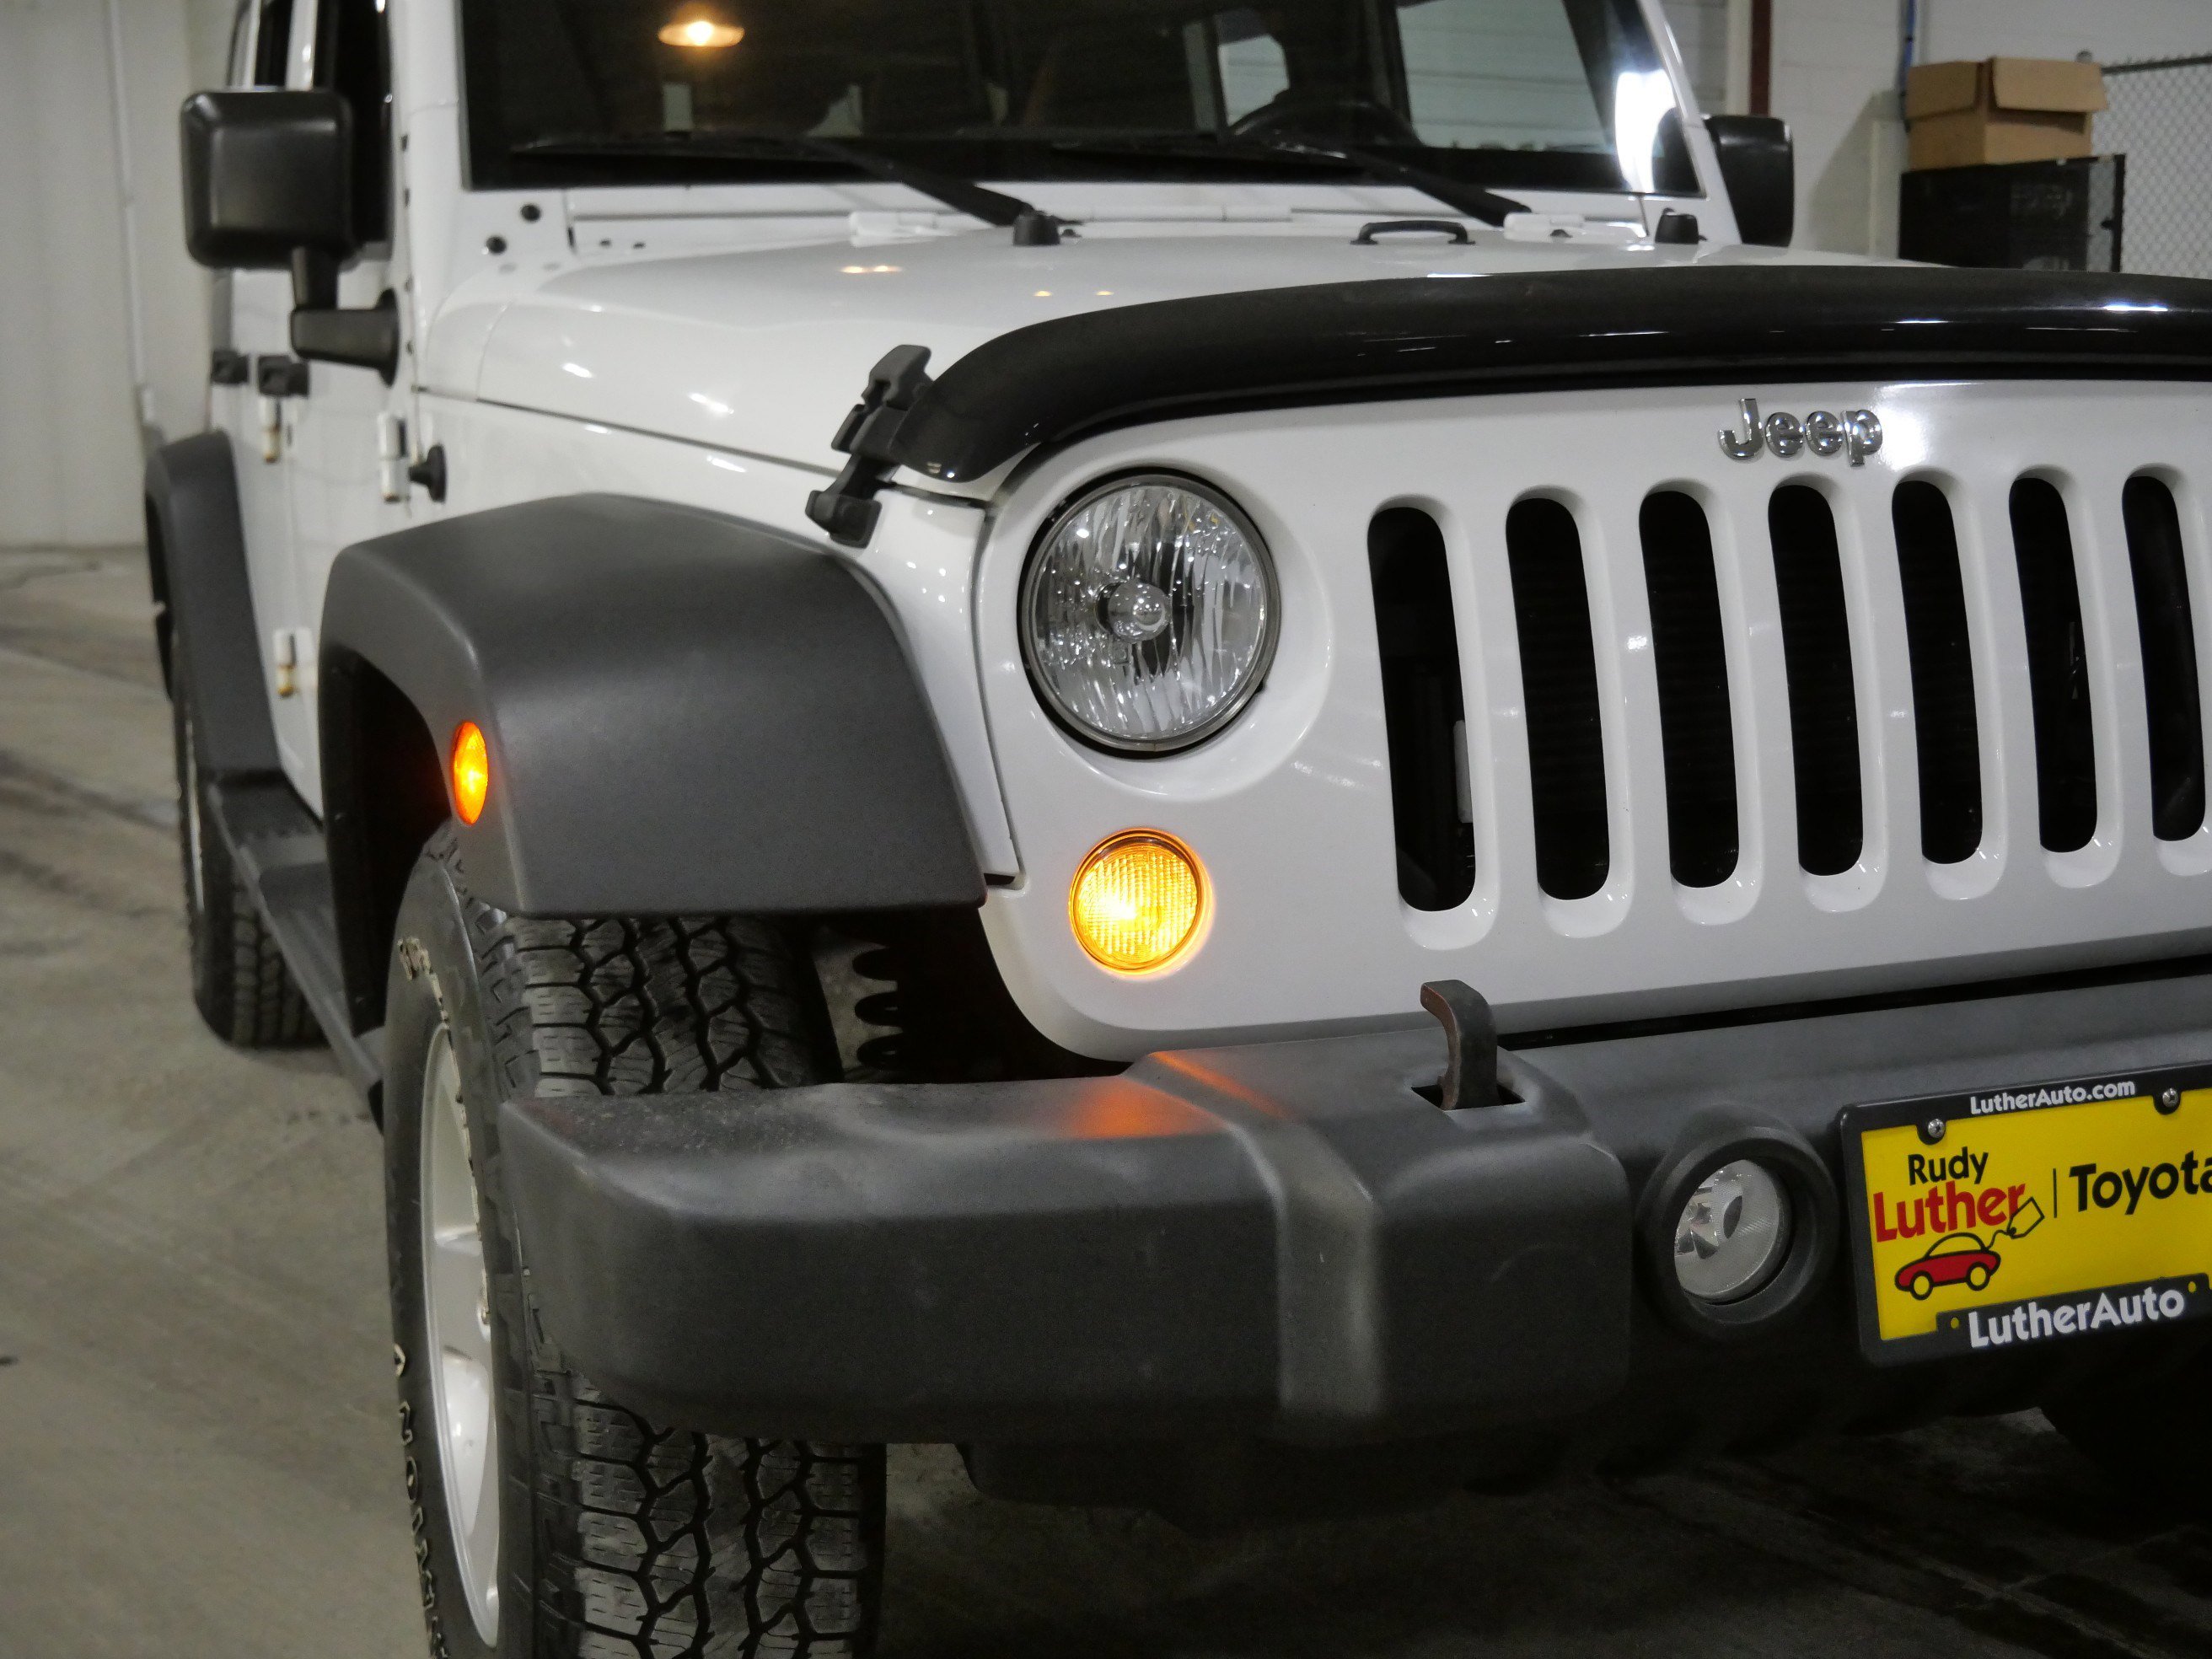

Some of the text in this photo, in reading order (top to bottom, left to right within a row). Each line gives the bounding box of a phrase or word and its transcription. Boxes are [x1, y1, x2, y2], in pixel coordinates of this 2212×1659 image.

[1717, 398, 1883, 467] Jeep
[1969, 1080, 2136, 1115] LutherAuto.com
[1908, 1146, 1989, 1186] Rudy
[1873, 1180, 2026, 1243] Luther
[1968, 1286, 2185, 1349] LutherAuto
